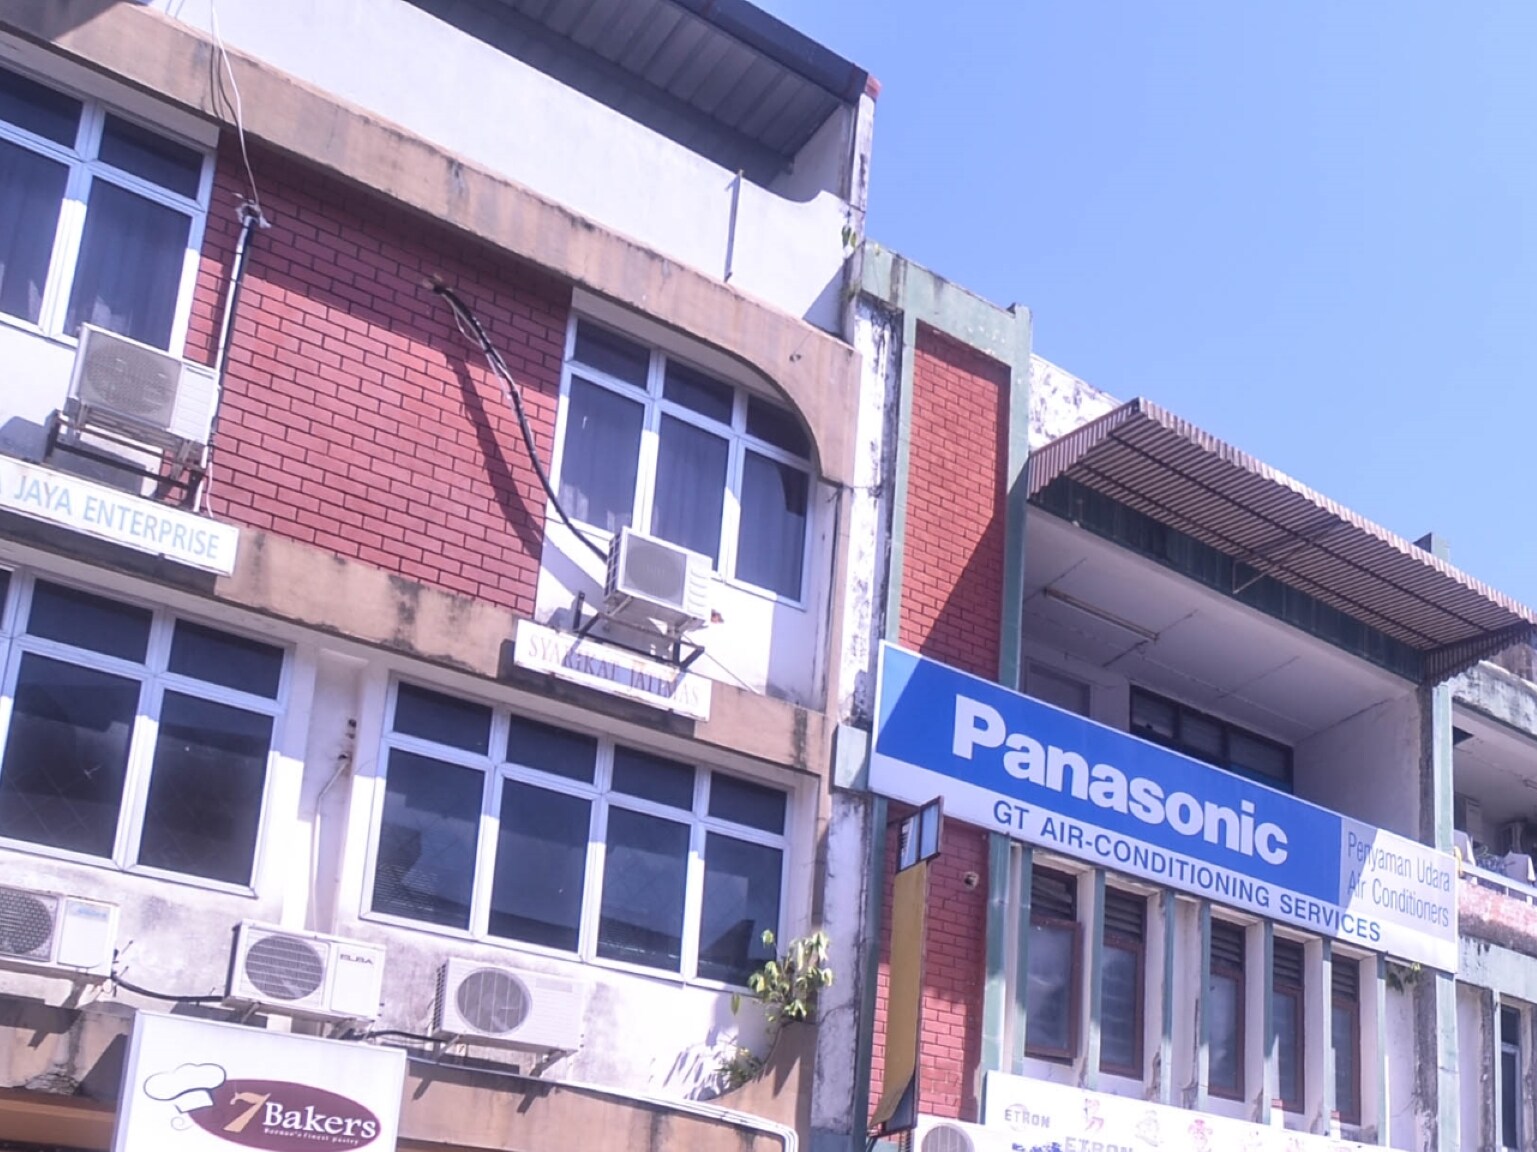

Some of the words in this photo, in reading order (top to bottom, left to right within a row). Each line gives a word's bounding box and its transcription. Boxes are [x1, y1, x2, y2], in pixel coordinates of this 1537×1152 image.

[14, 475, 72, 516] JAYA
[83, 495, 220, 560] ENTERPRISE
[952, 693, 1289, 866] Panasonic
[993, 799, 1029, 830] GT
[1040, 816, 1270, 908] AIR-CONDITIONING
[1280, 893, 1382, 943] SERVICES
[1348, 831, 1413, 880] Penyaman
[1417, 856, 1450, 893] Udara
[1348, 870, 1366, 899] Air
[1372, 878, 1450, 928] Conditioners
[339, 953, 375, 966] ELBA
[223, 1091, 271, 1133] 7
[263, 1101, 377, 1139] Bakers
[303, 1132, 330, 1142] finest
[332, 1135, 359, 1146] pastry
[1004, 1108, 1051, 1129] ETRON
